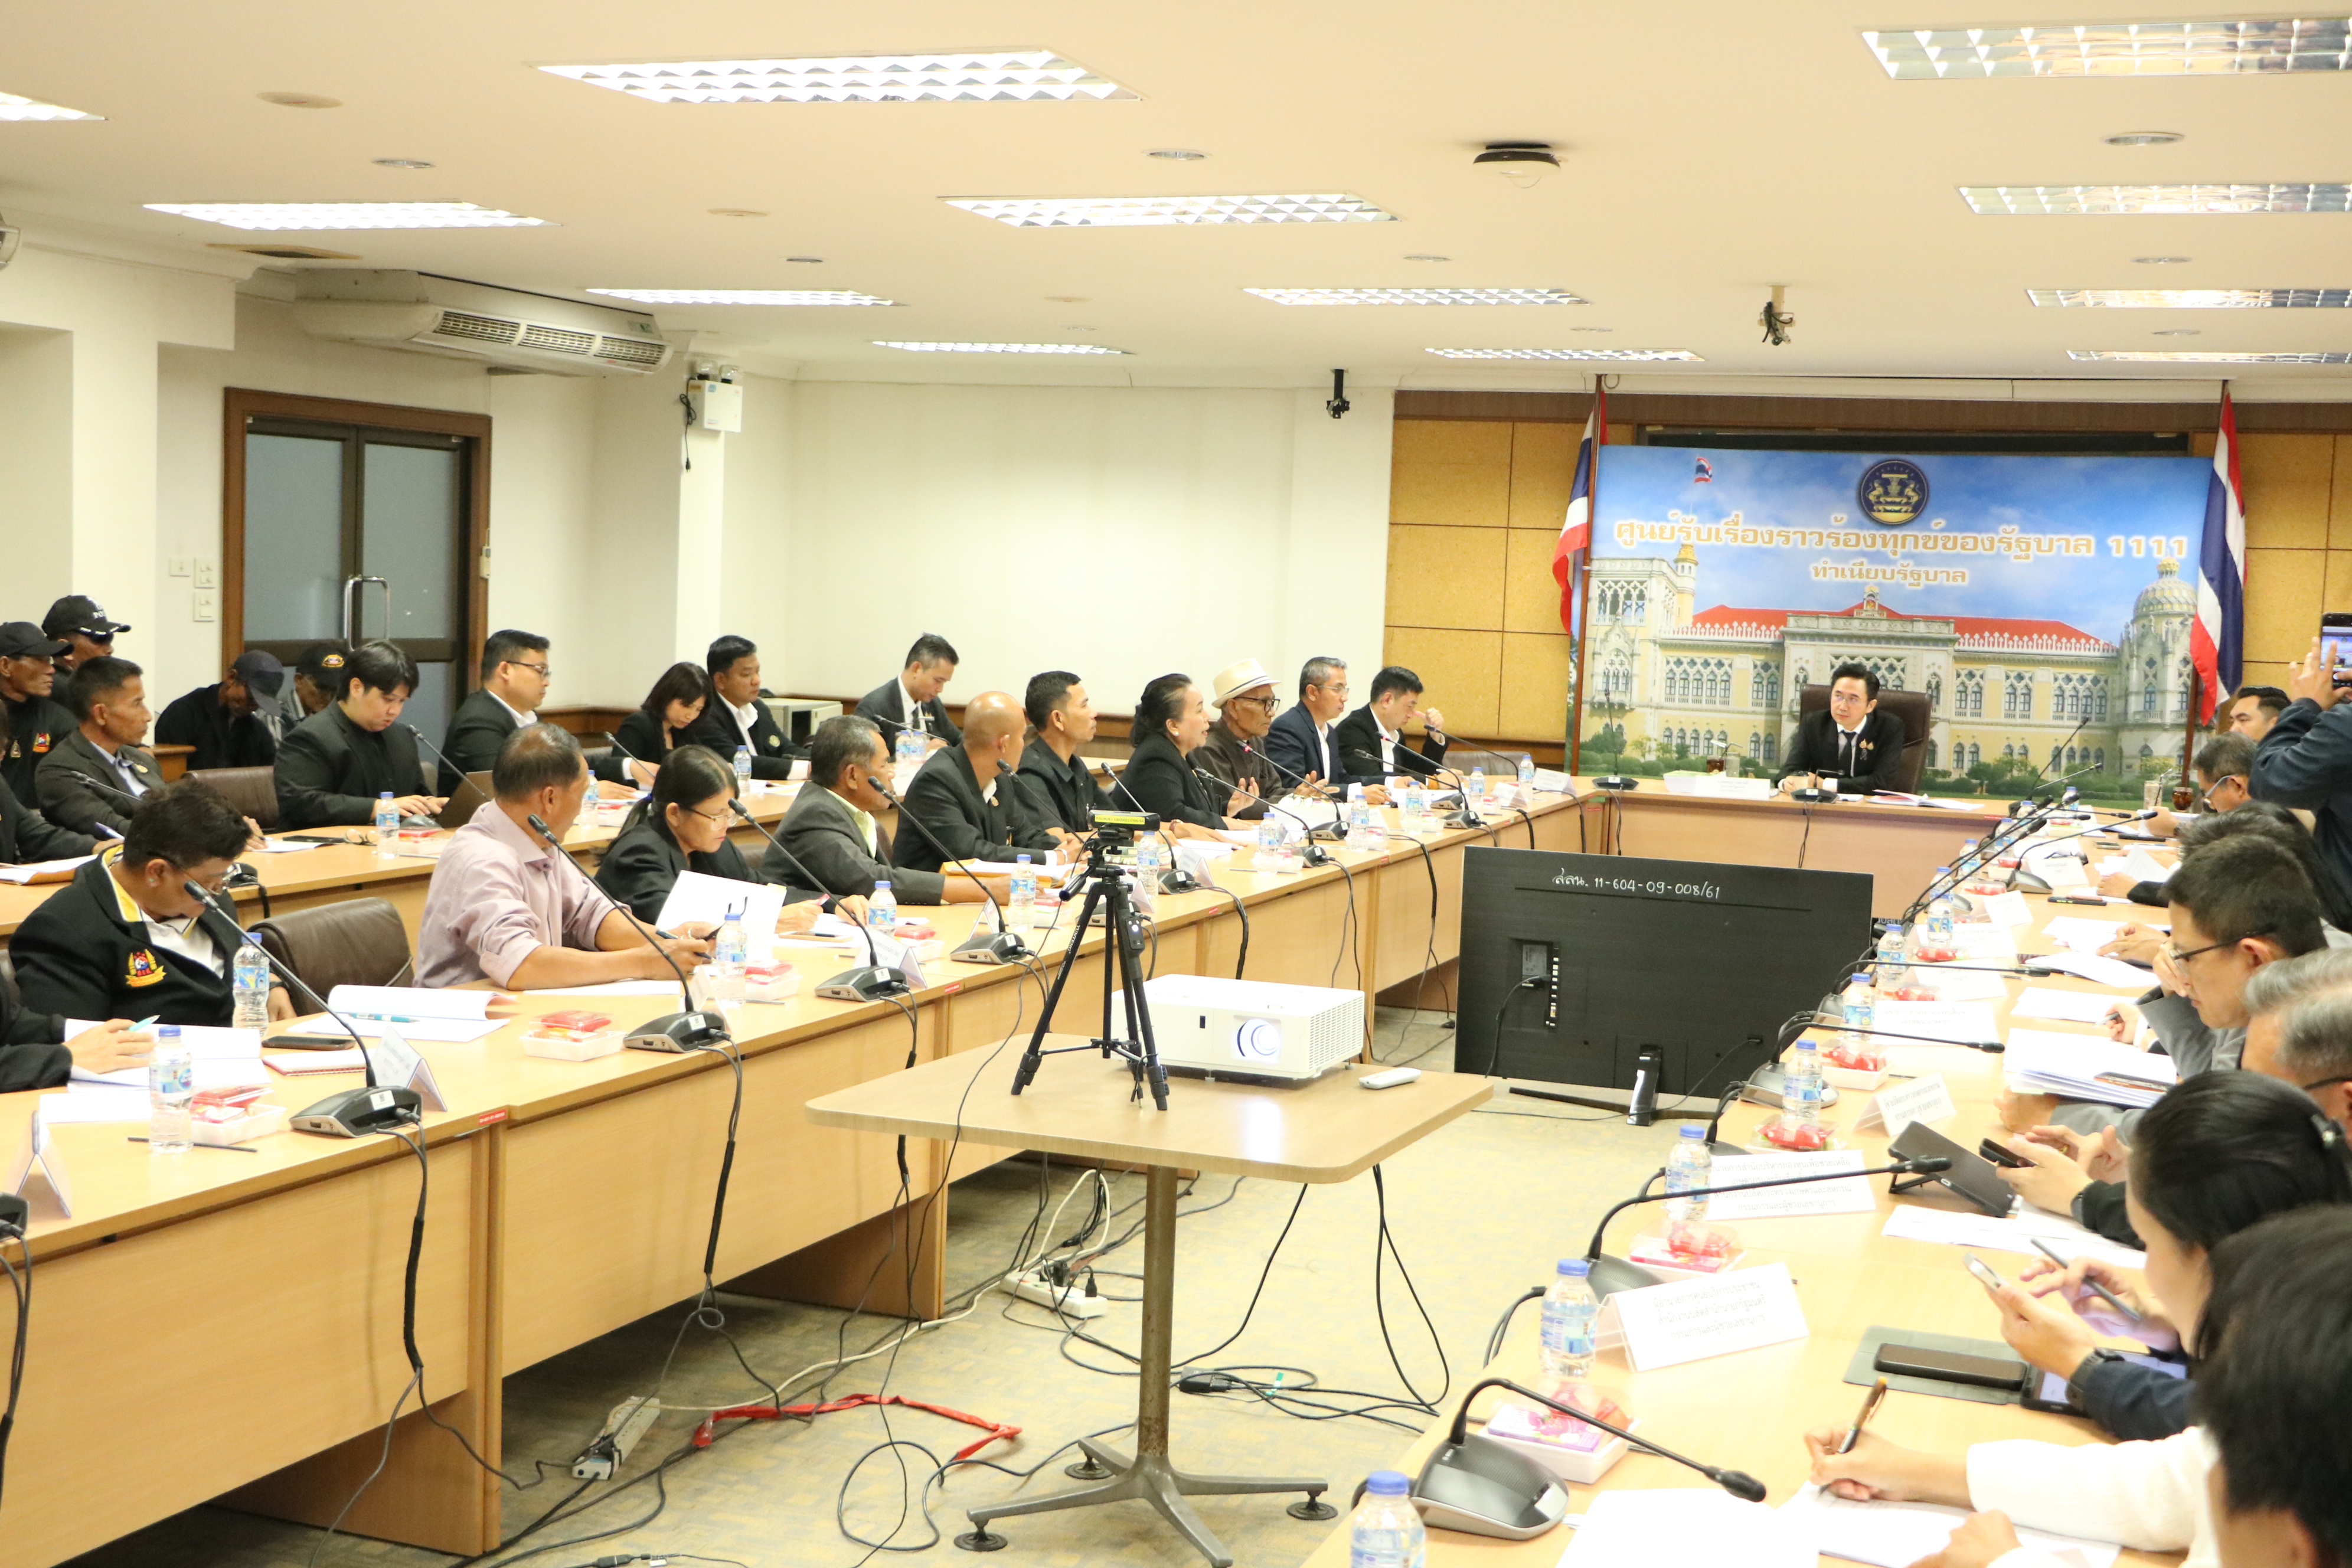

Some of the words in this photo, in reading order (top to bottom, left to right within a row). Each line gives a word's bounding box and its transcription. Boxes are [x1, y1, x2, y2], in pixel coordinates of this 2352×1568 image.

[1615, 512, 2093, 560] ศูนย์รับเรื่องราวร้องทุกข์ของรัฐบาล
[2109, 537, 2187, 556] 1111
[1812, 560, 1966, 586] ทำเนียบรัฐบาล
[1593, 877, 1720, 899] 11-604-09-008/61
[1067, 925, 1081, 952] YUNTENG
